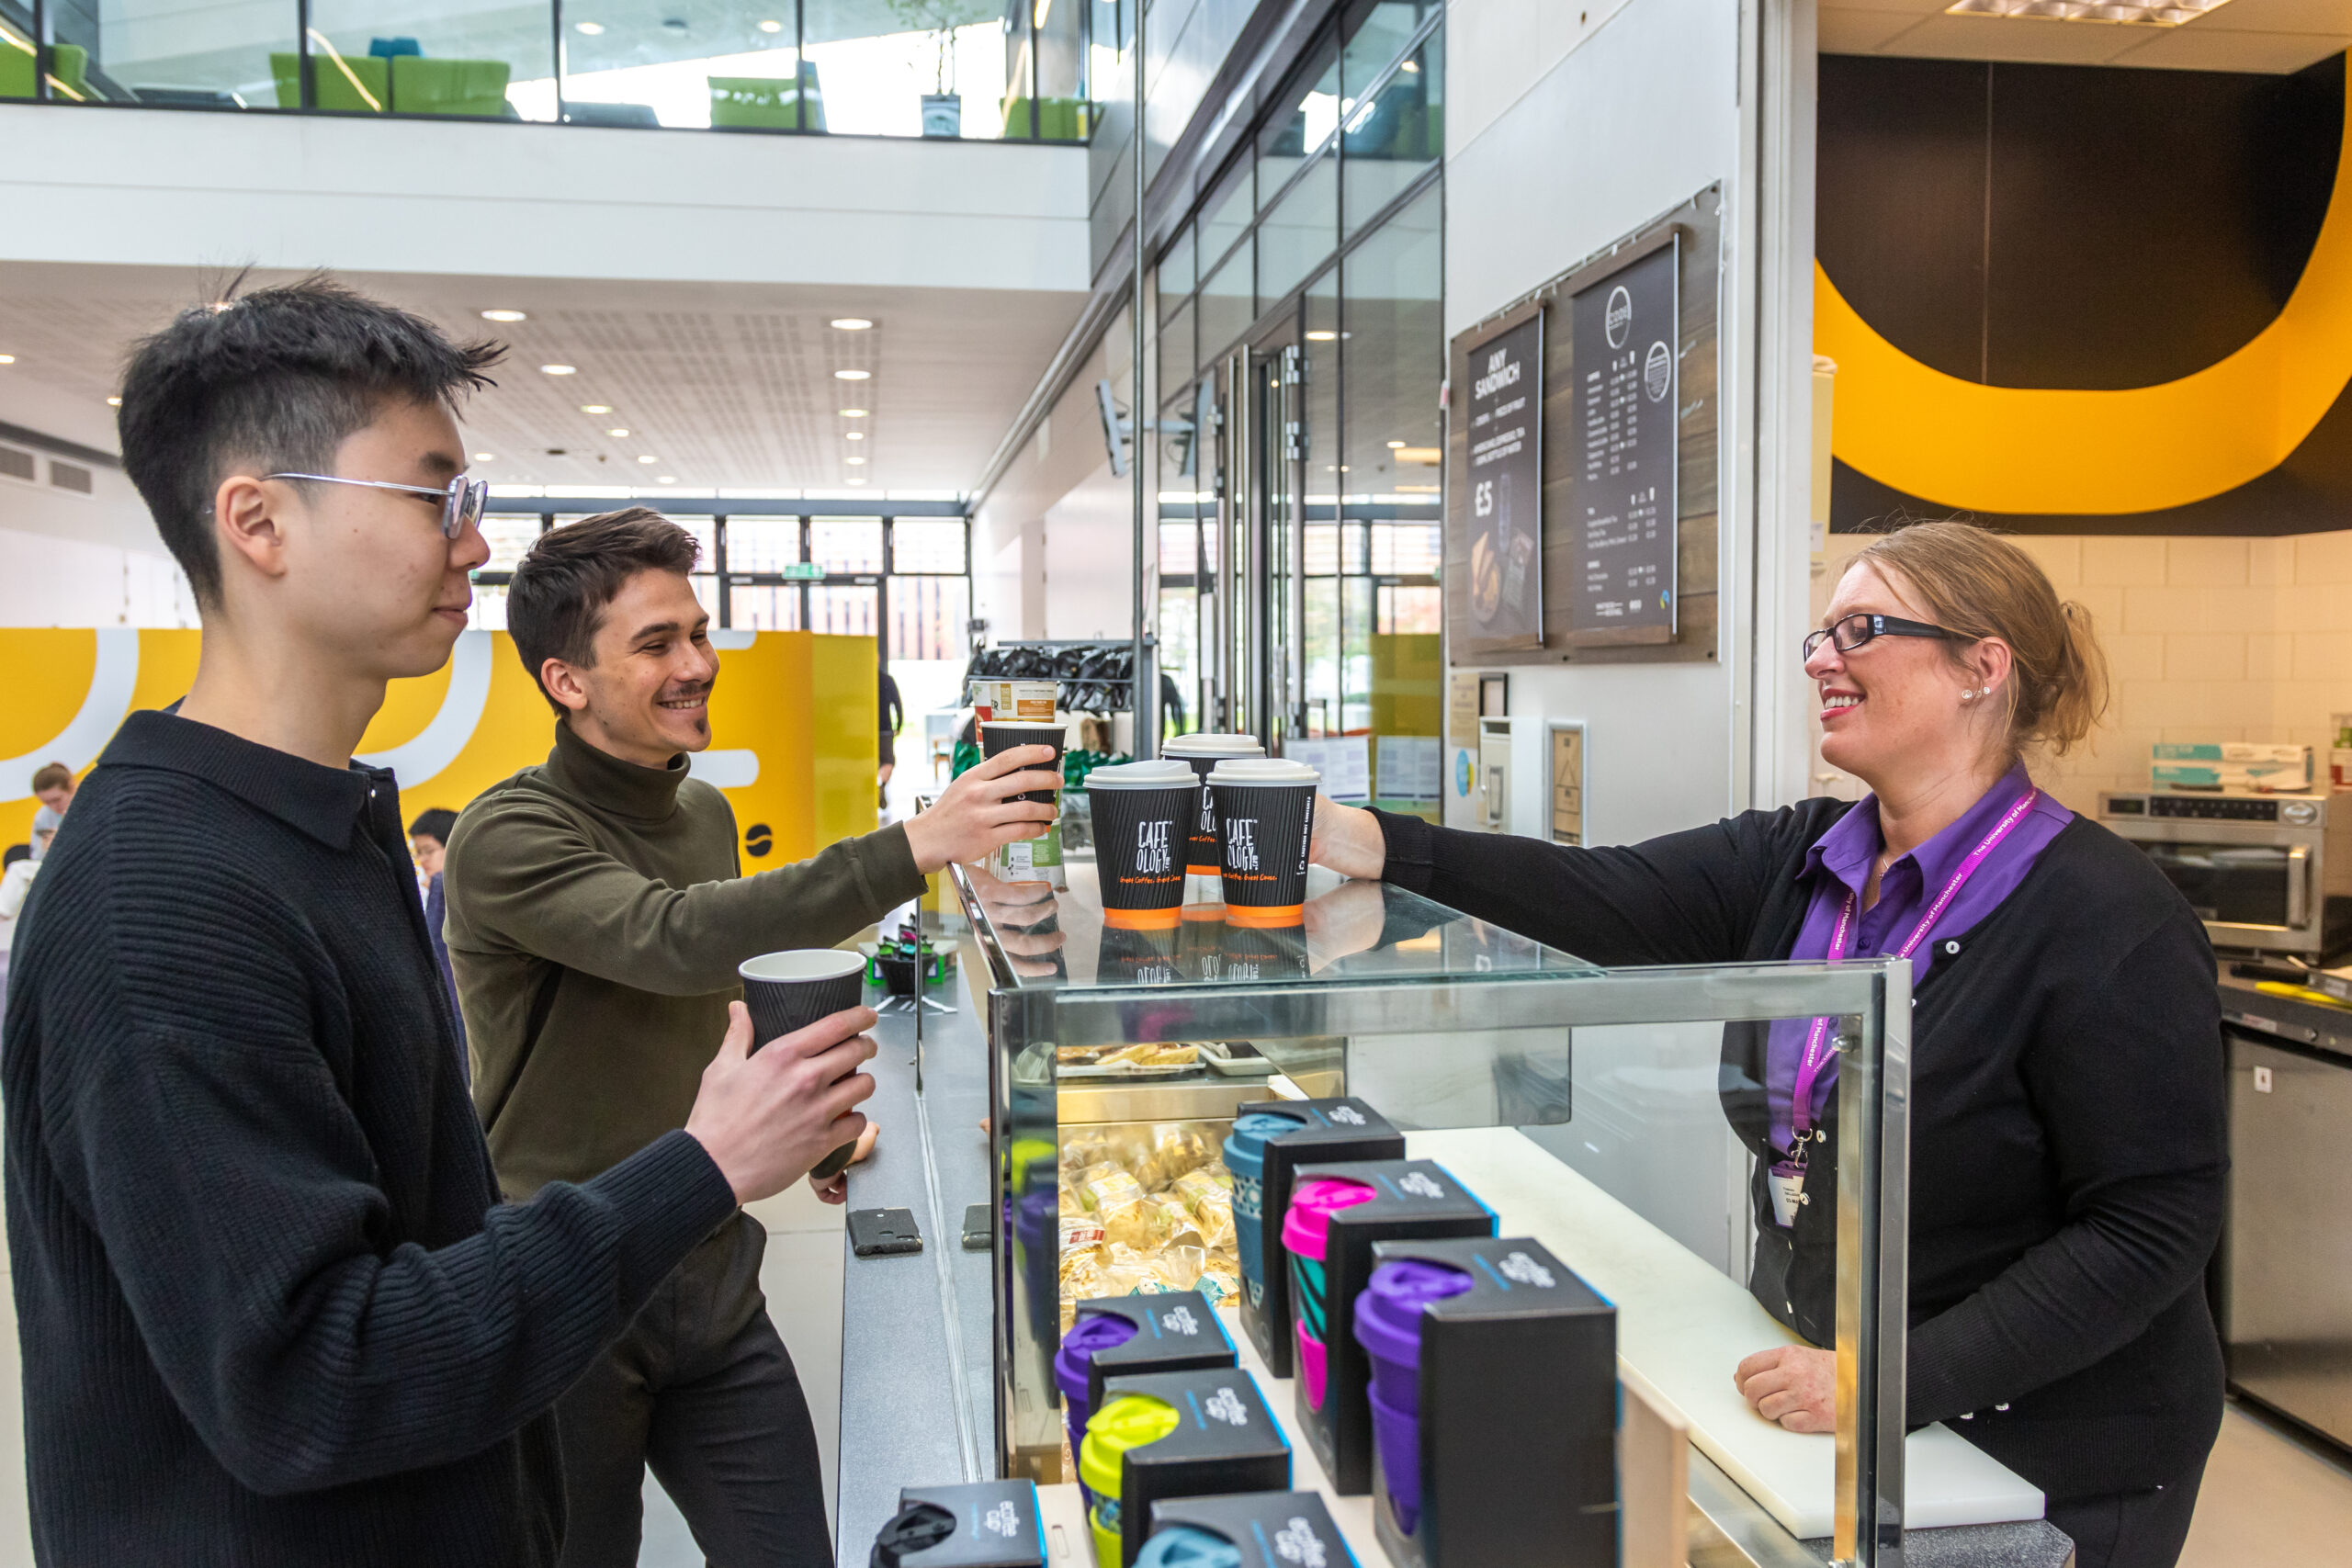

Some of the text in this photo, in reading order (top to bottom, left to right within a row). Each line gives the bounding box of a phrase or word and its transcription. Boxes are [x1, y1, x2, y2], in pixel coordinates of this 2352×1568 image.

[1487, 348, 1507, 374] ANY
[1475, 361, 1521, 400] SANDWICH
[1475, 480, 1492, 516] £5
[1138, 820, 1169, 849] CAFE
[1227, 818, 1253, 847] CAFE
[1973, 845, 1986, 856] The
[1984, 817, 2014, 846] University
[2011, 808, 2019, 818] of
[1136, 848, 1168, 874] OLOGY
[1227, 845, 1254, 871] OLOGY
[1904, 873, 1963, 953] University of Manchester
[1834, 912, 1850, 951] Manchester
[1807, 1018, 1823, 1066] of Manchester
